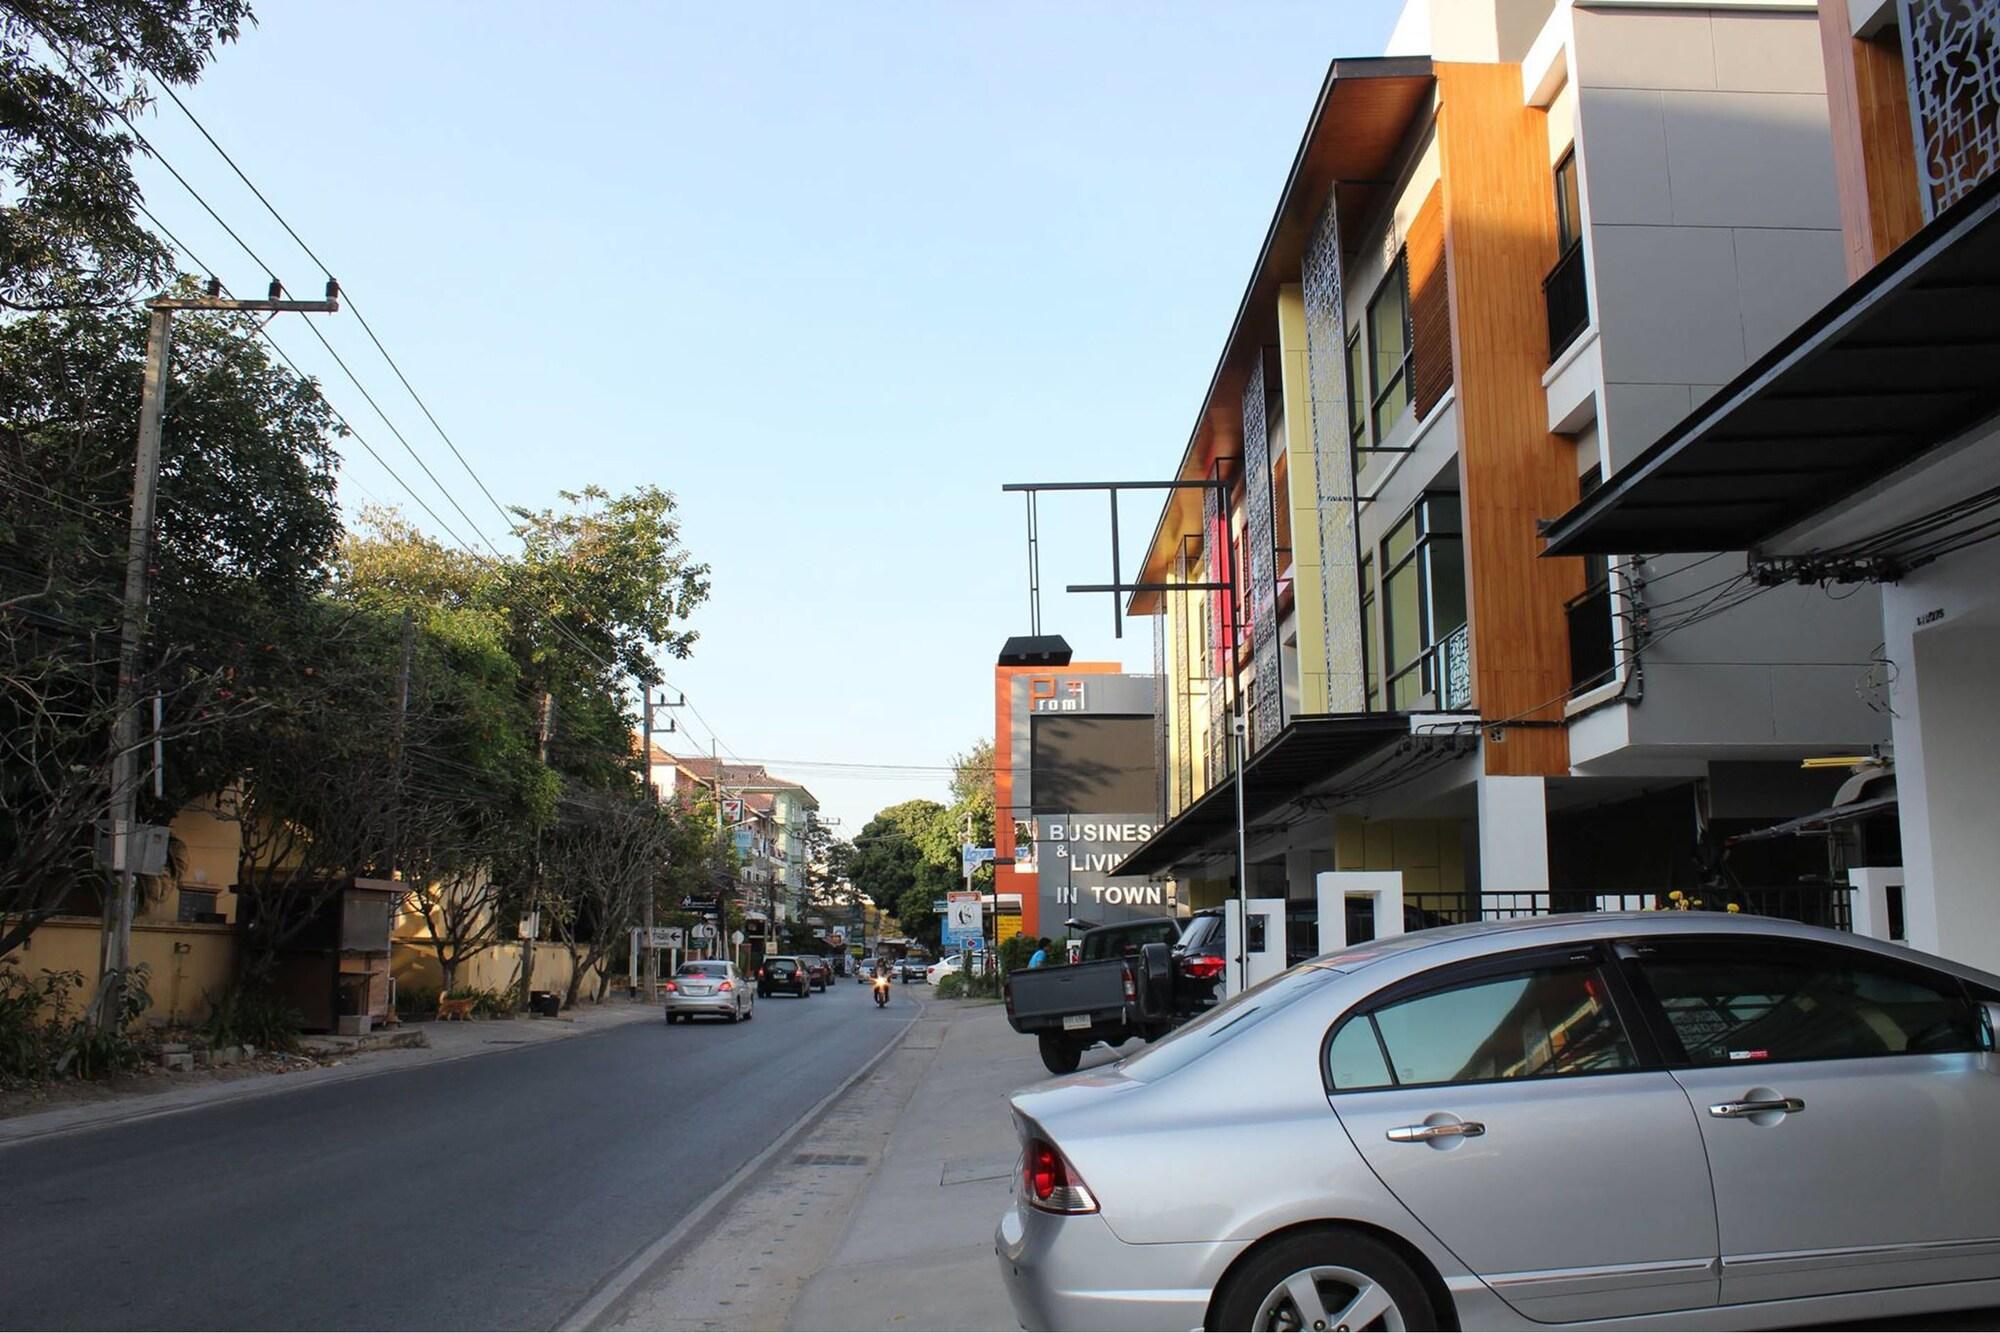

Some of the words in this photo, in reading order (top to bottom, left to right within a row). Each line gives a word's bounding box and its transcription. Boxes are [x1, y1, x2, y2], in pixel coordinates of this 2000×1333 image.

[1056, 844, 1068, 857] &
[1071, 854, 1129, 872] LIVIN
[1057, 887, 1078, 904] IN
[1091, 886, 1161, 904] TOWN
